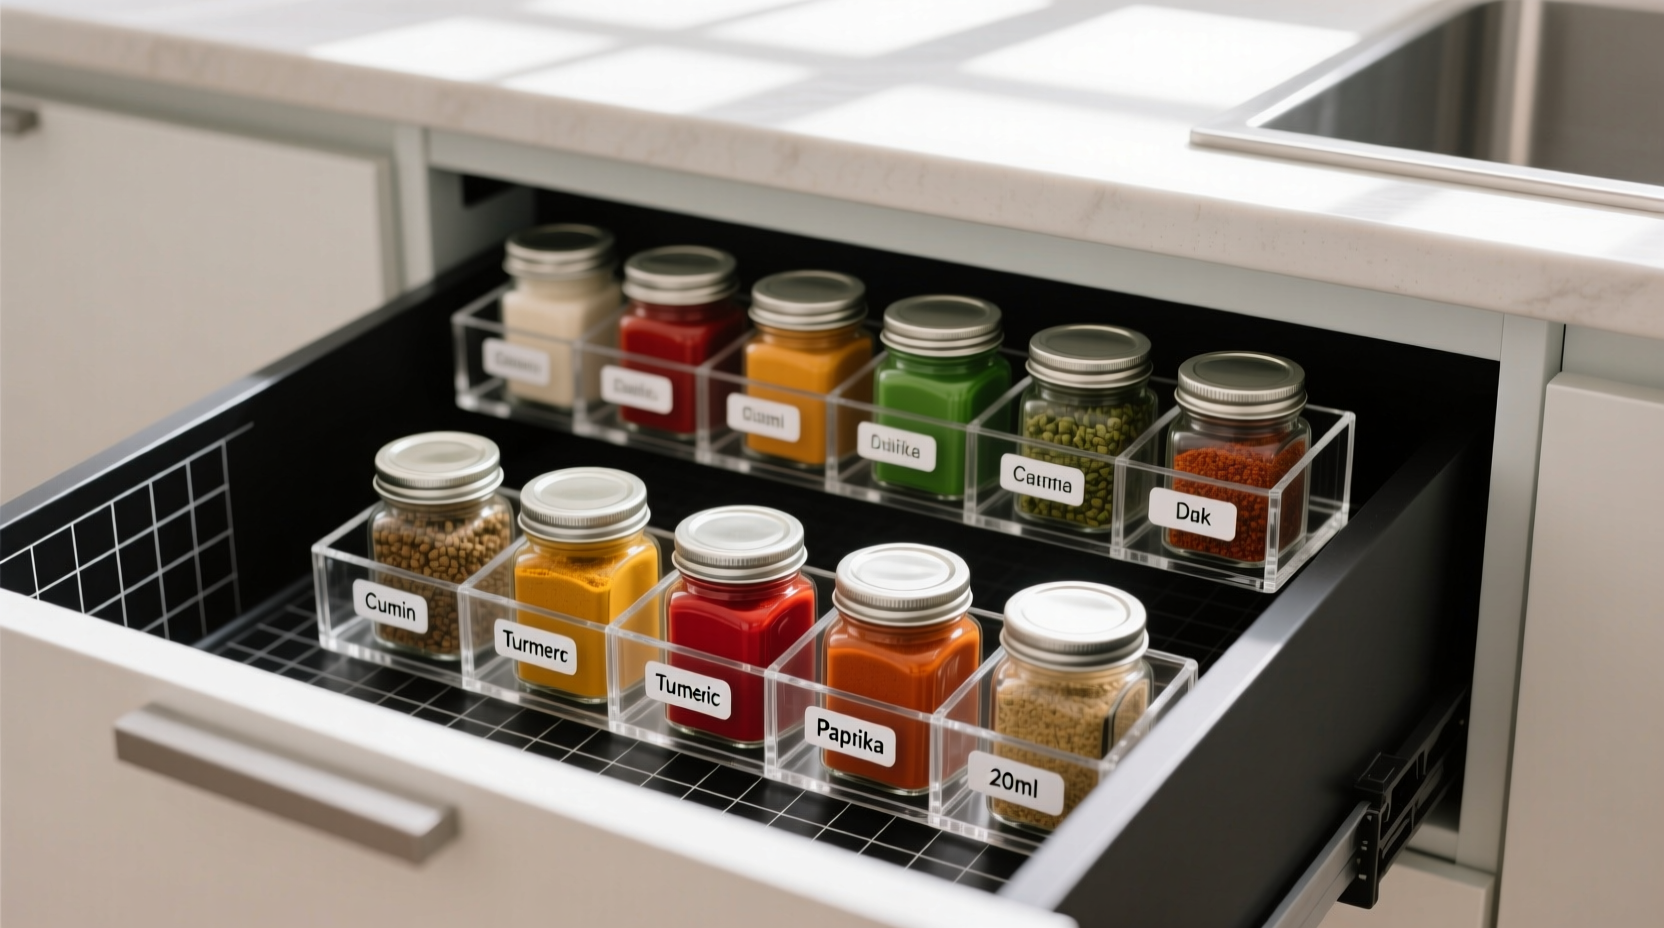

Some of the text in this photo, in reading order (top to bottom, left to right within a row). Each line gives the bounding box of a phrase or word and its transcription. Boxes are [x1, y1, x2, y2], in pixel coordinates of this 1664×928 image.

[365, 592, 416, 621] Cumin
[655, 673, 720, 706] Tumeric
[817, 718, 884, 754] Paprika
[989, 768, 1038, 798] 20ml
